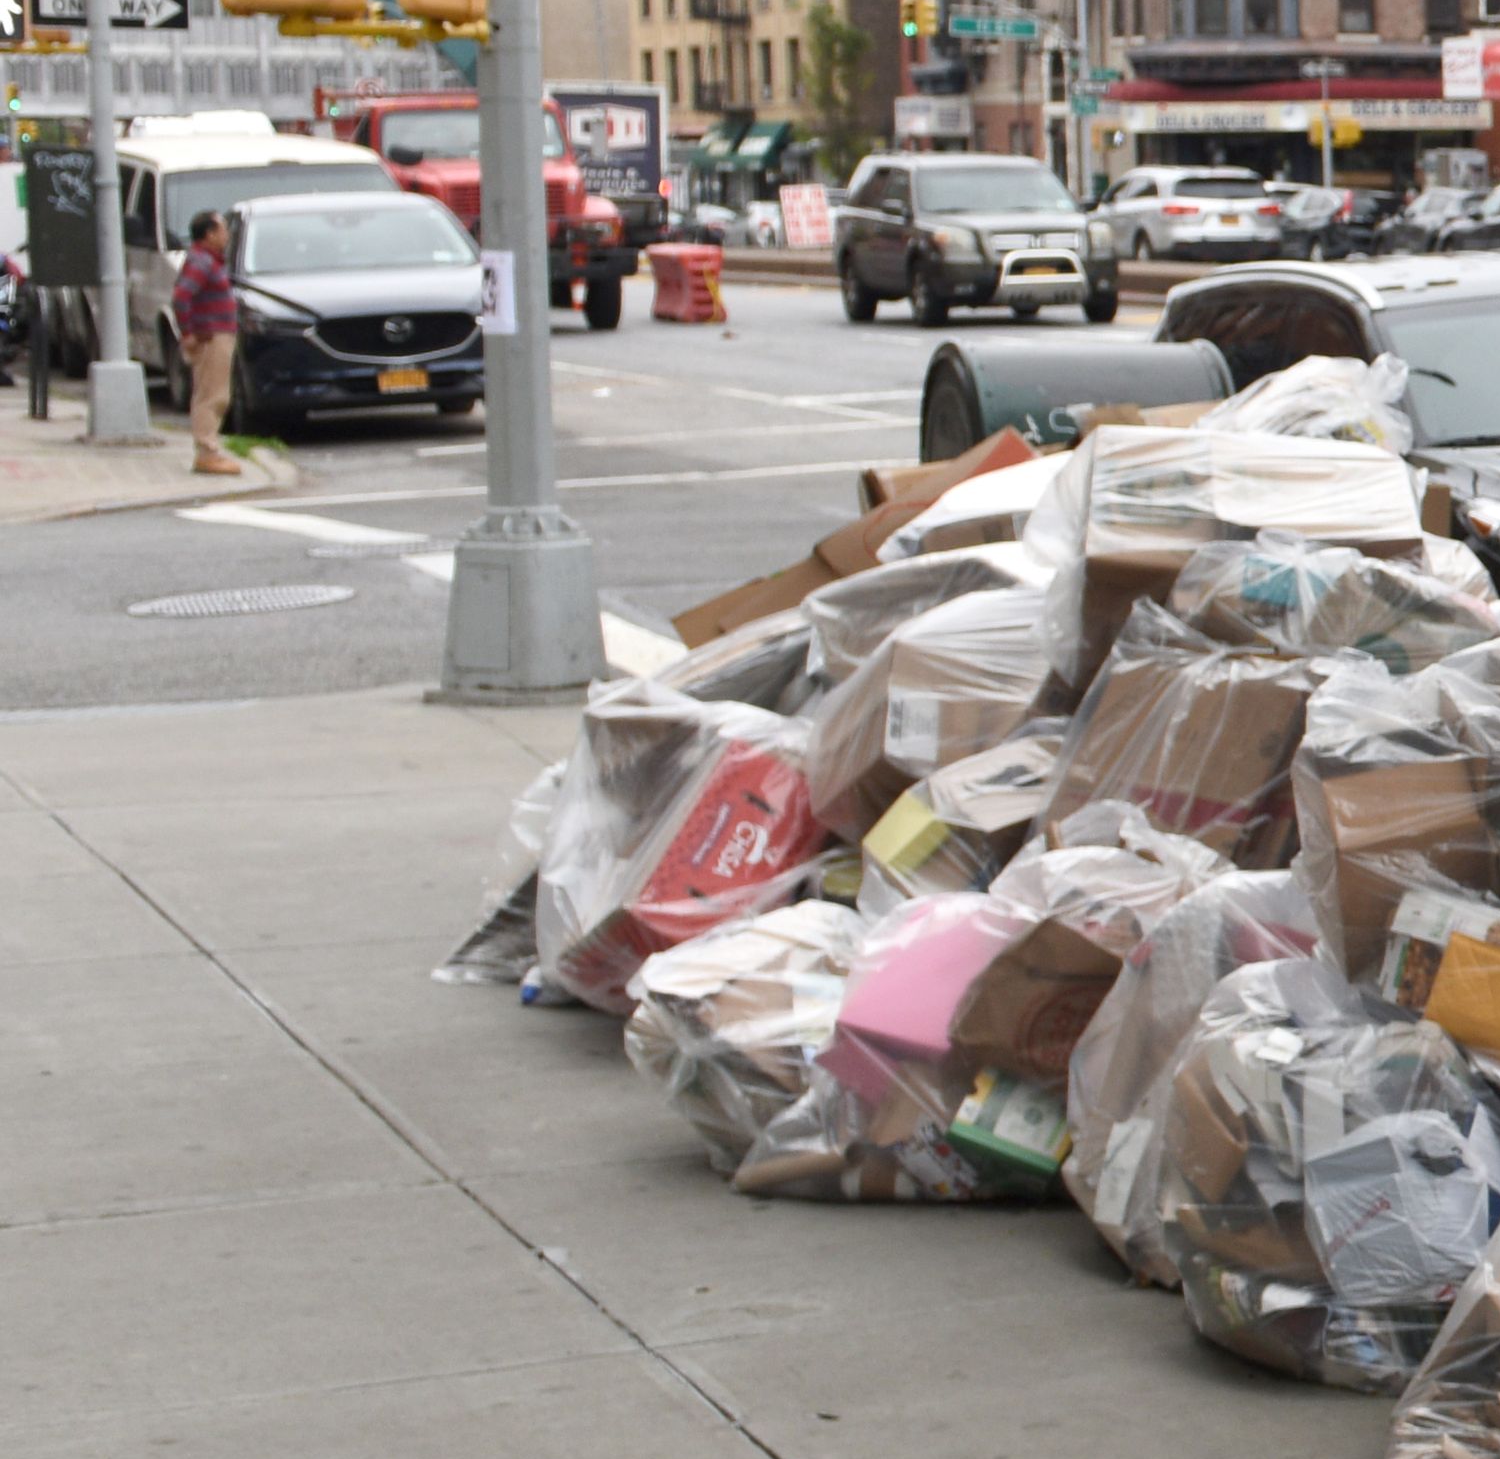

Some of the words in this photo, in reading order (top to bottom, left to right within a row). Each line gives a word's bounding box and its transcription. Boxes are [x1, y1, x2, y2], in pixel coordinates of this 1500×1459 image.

[1352, 99, 1386, 116] DELI
[1407, 99, 1480, 117] GROCERY
[1202, 114, 1268, 129] GROCERY
